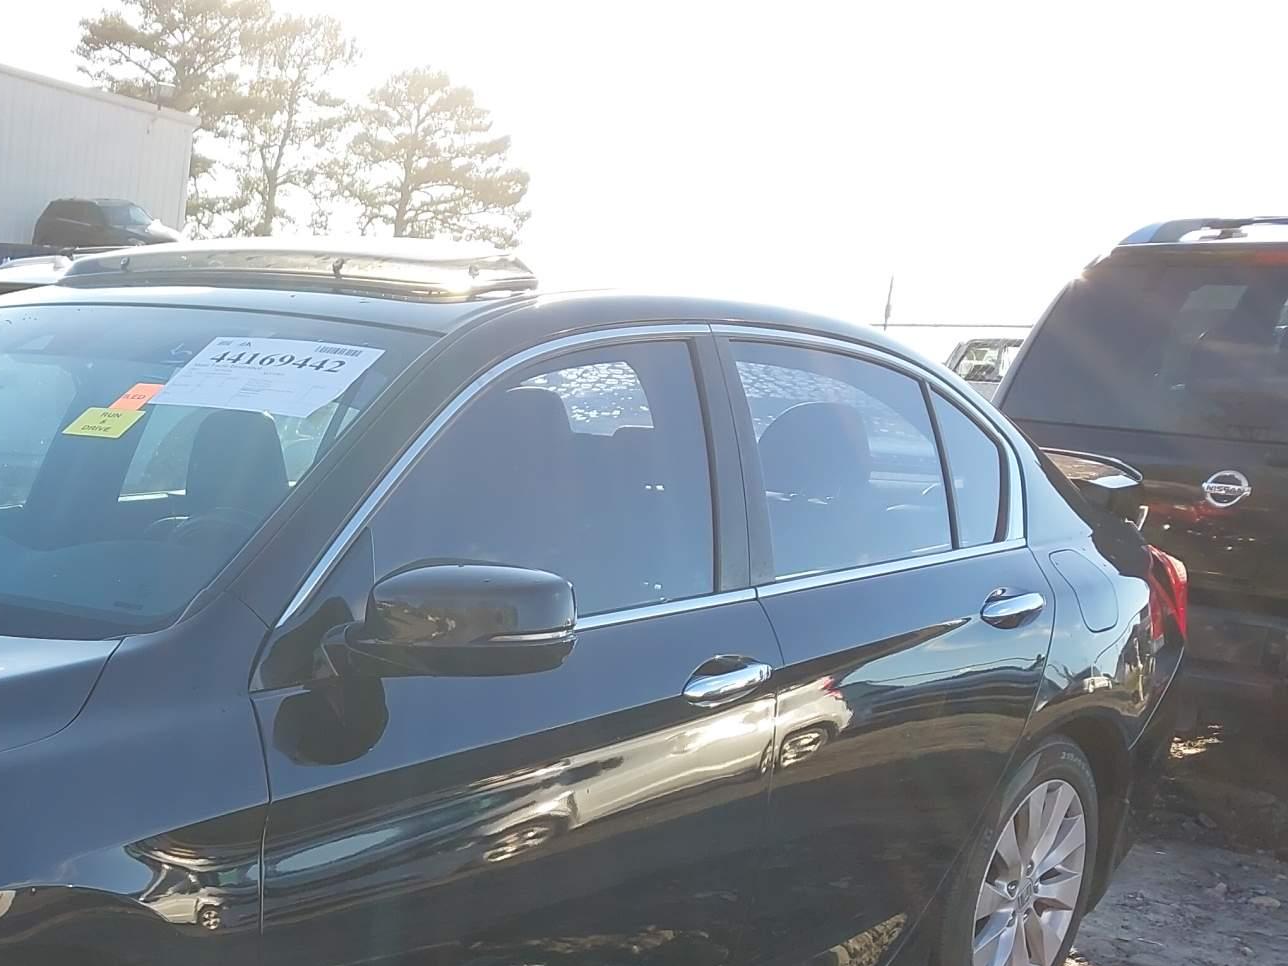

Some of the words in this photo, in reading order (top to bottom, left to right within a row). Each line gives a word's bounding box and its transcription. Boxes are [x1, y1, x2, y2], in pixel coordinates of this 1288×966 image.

[211, 350, 346, 373] 44169442
[81, 424, 111, 433] DRIVE
[1207, 485, 1243, 496] NISSAN
